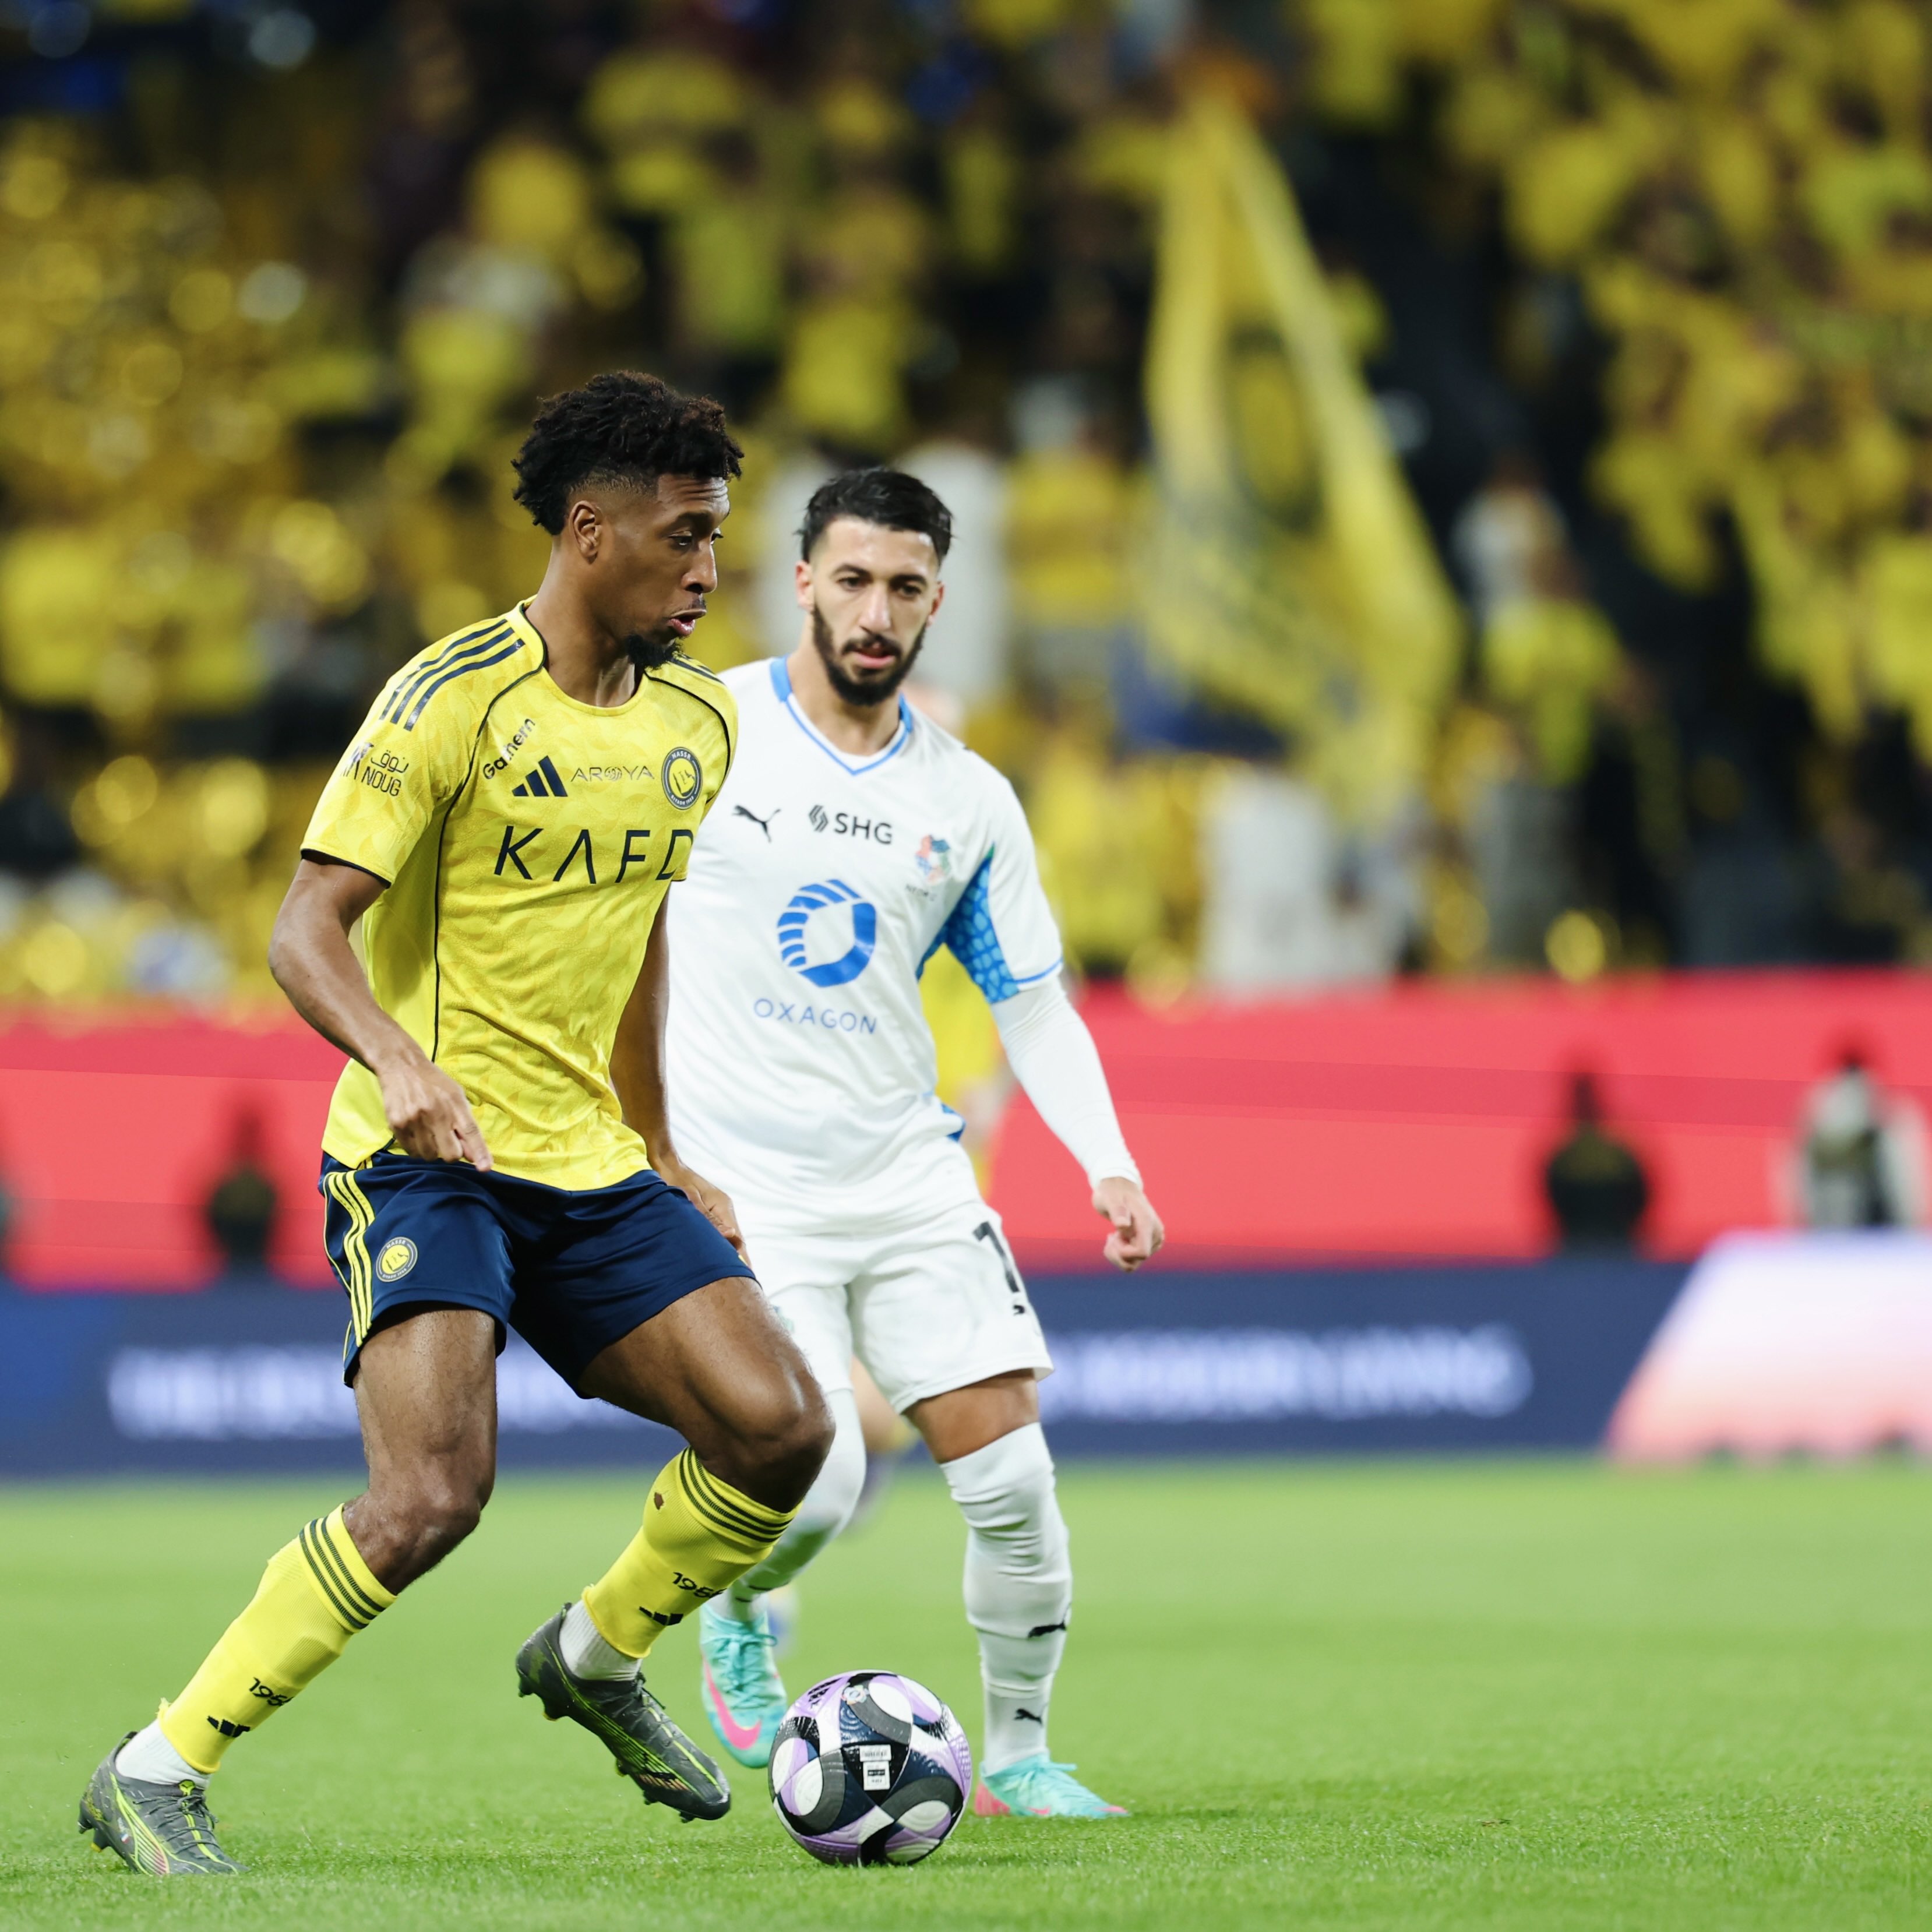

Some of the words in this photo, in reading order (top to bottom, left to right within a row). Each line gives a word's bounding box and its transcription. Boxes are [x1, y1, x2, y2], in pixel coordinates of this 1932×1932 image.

[371, 750, 409, 773] نوق
[671, 750, 691, 760] NASSR
[361, 766, 401, 796] NOUG
[570, 765, 655, 782] AROYA
[834, 812, 893, 845] SHG
[494, 826, 693, 884] KAFD
[753, 998, 877, 1034] OXAGON
[249, 1677, 294, 1706] 195
